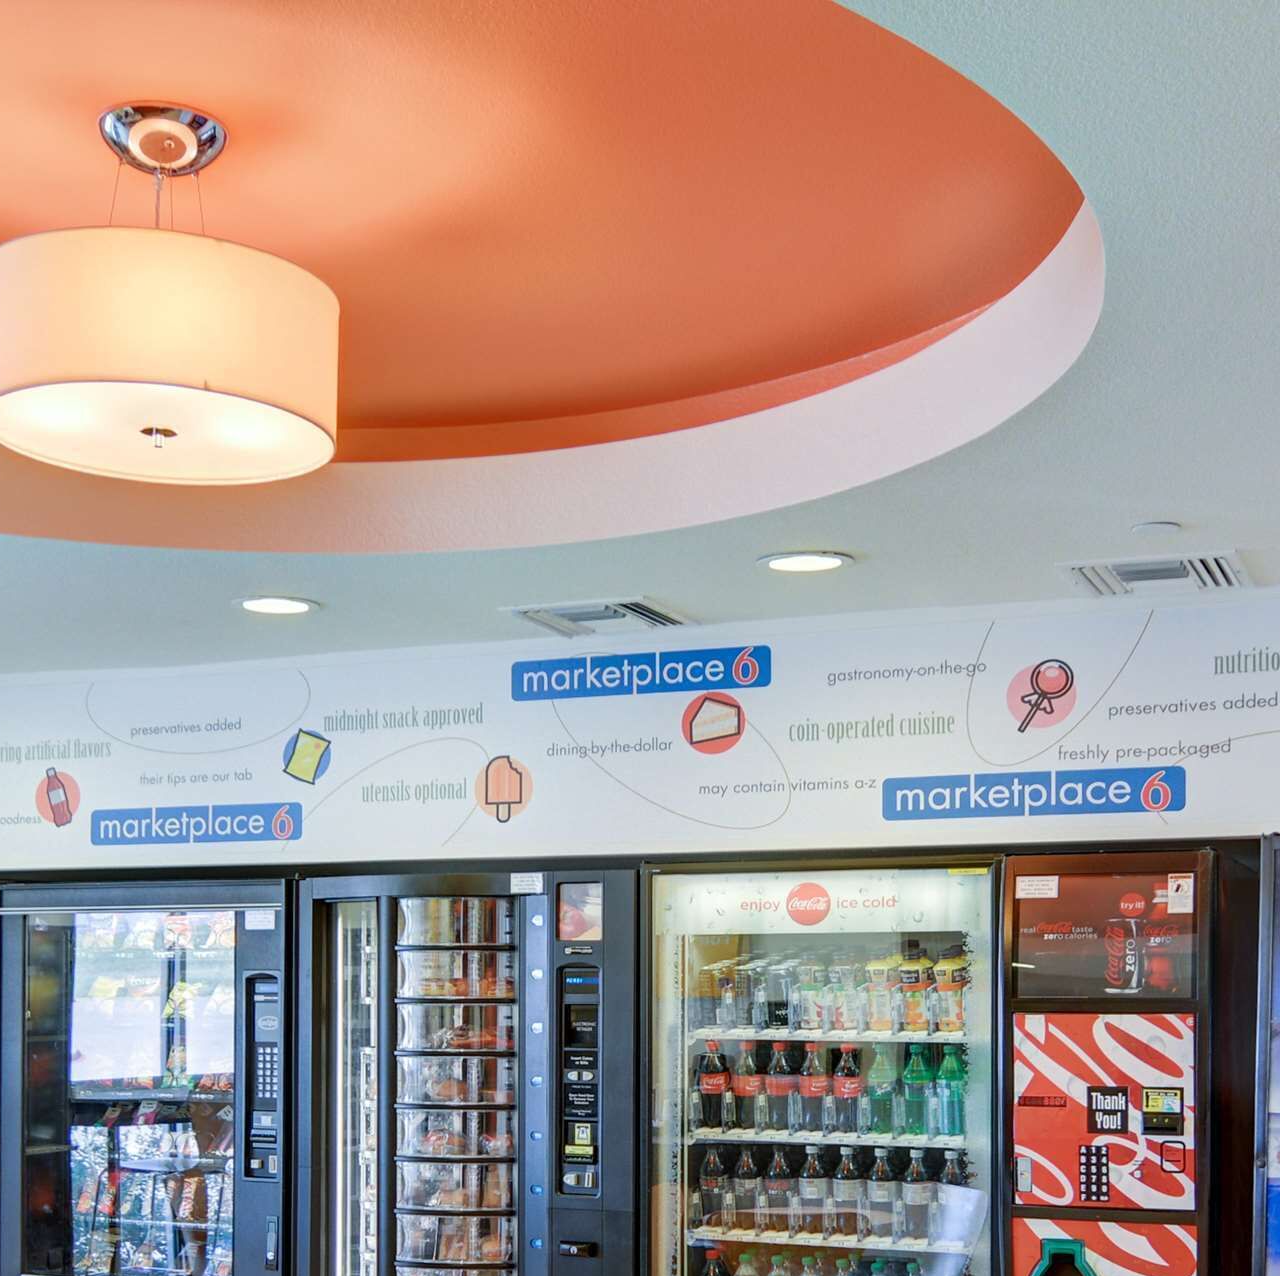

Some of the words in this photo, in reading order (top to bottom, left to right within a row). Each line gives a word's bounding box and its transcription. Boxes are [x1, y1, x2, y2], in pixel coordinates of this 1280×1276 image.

[523, 652, 724, 695] marketplace
[732, 647, 760, 686] 6
[827, 660, 986, 686] gastronomy-on-the-go
[1109, 699, 1216, 720] preservatives
[1223, 691, 1278, 709] added
[131, 725, 201, 739] preservatives
[204, 719, 241, 732] added
[324, 707, 379, 734] midnight
[382, 704, 419, 728] snack
[423, 702, 484, 730] approved
[900, 711, 955, 736] cuisine
[24, 740, 71, 761] artificial
[73, 738, 111, 759] flavors
[1058, 744, 1109, 762] freshly
[1116, 738, 1232, 760] pre-packaged
[139, 772, 163, 785] their
[166, 772, 187, 786] tips
[190, 773, 208, 784] are
[211, 772, 230, 783] our
[232, 770, 253, 782] tab
[699, 783, 727, 797] may
[733, 780, 785, 794] contain
[790, 777, 849, 791] vitamins
[854, 778, 876, 790] a-z
[362, 779, 411, 802] utensils
[414, 777, 467, 804] optional
[896, 769, 1131, 816] marketplace
[1140, 770, 1172, 812] 6
[100, 804, 265, 844] marketplace
[272, 804, 294, 839] 6
[740, 898, 781, 912] enjoy
[836, 896, 858, 909] ice
[863, 896, 896, 909] cold
[1120, 901, 1134, 910] try
[1044, 933, 1064, 941] zero
[1065, 932, 1098, 940] calories
[1072, 925, 1093, 934] taste
[1126, 939, 1136, 972] zero
[1091, 1092, 1126, 1111] Thank
[1095, 1111, 1121, 1129] You!
